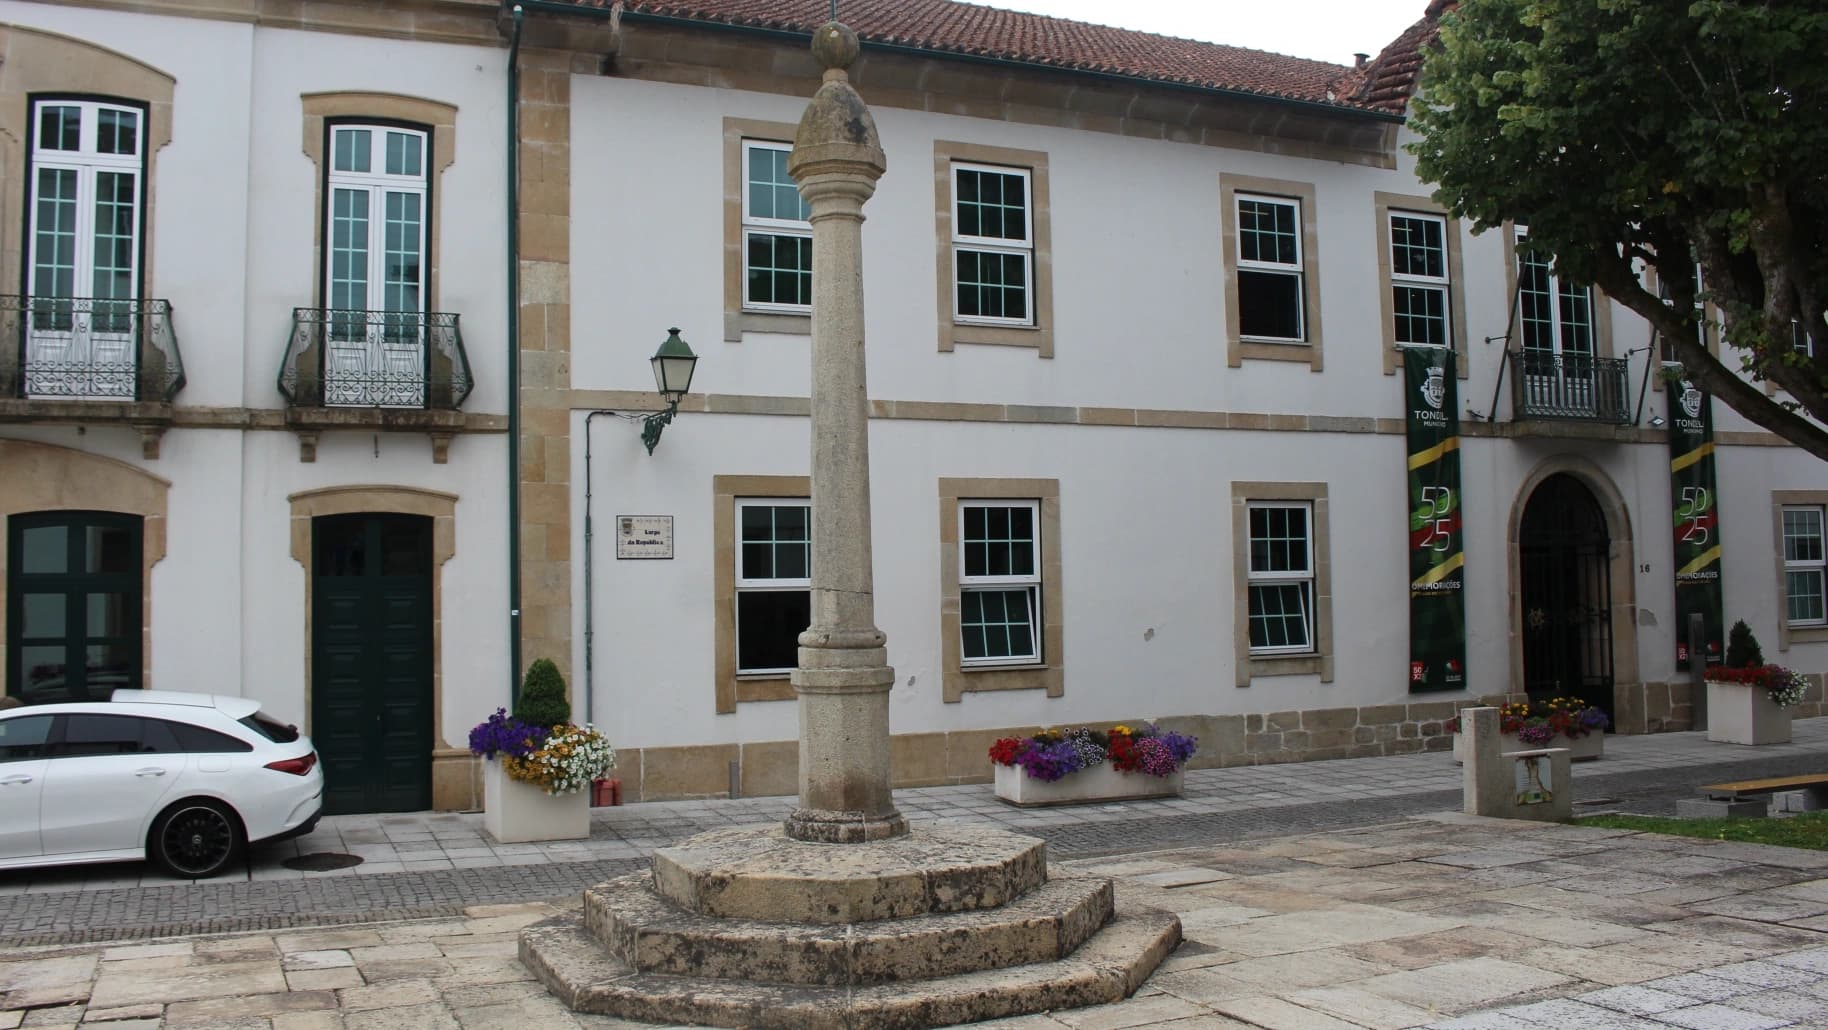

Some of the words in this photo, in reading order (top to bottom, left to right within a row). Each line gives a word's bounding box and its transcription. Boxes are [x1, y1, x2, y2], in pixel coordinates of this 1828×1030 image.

[1418, 486, 1451, 519] 50
[1679, 486, 1707, 516] 50
[1419, 518, 1451, 552] 25
[1681, 515, 1709, 545] 25
[1639, 564, 1650, 573] 16
